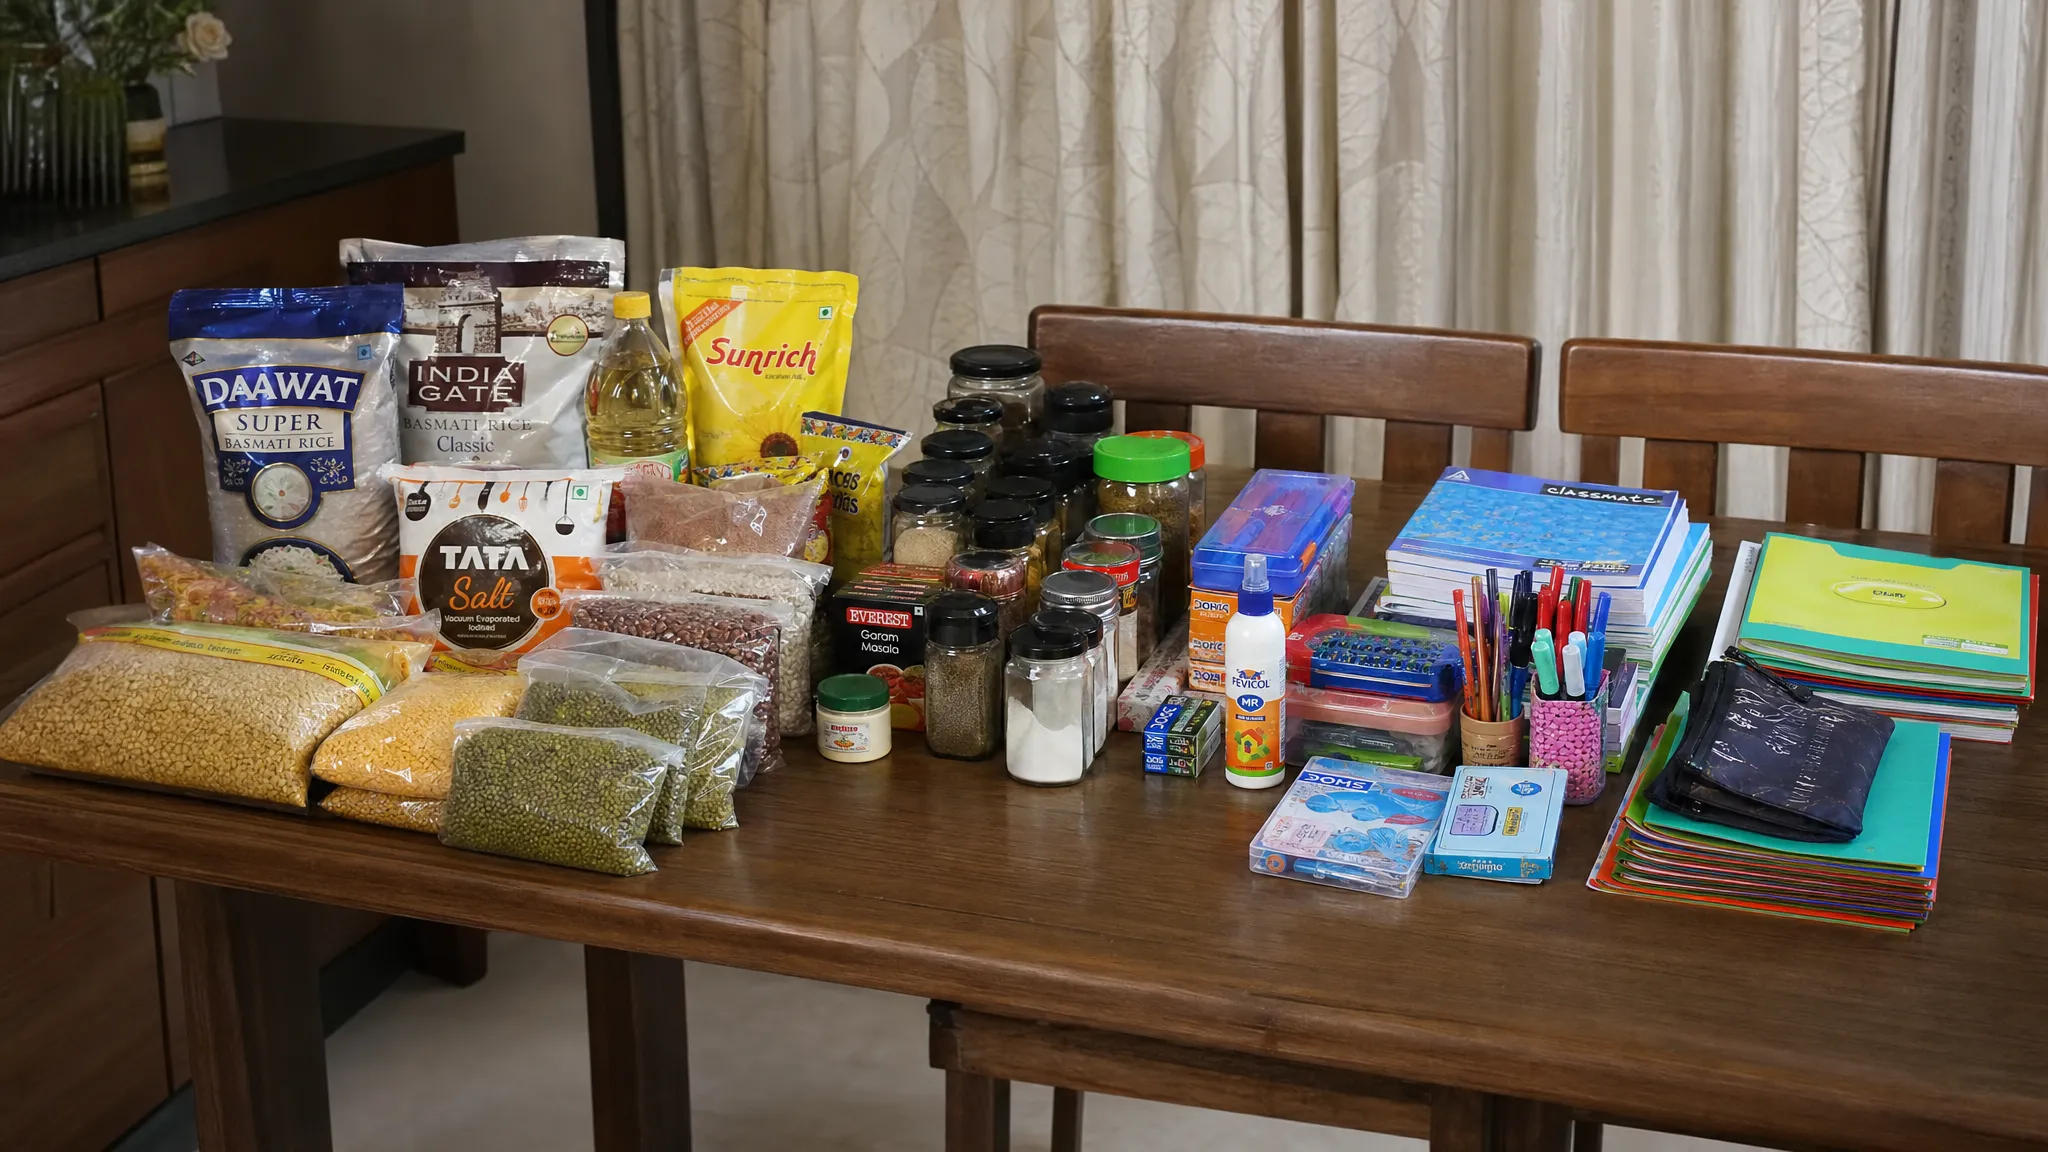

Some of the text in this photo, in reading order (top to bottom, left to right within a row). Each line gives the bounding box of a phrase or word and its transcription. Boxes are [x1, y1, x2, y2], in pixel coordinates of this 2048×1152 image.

[706, 338, 817, 375] Sunrich
[417, 366, 516, 383] INDIA
[201, 372, 358, 406] DAAWAT
[418, 386, 513, 402] GATE
[237, 414, 322, 431] SUPER
[404, 418, 532, 431] BASMATI RICE
[225, 437, 334, 449] BASMATI RICE
[437, 436, 494, 452] Classic
[440, 546, 529, 570] TATA
[449, 576, 514, 610] Salt
[476, 615, 520, 623] Evaporated
[849, 609, 909, 627] EVEREST
[861, 630, 899, 642] Garam
[861, 642, 899, 654] Masala
[1232, 677, 1270, 689] FEVICOL
[1241, 698, 1259, 707] MR
[1304, 773, 1366, 790] DOMS
